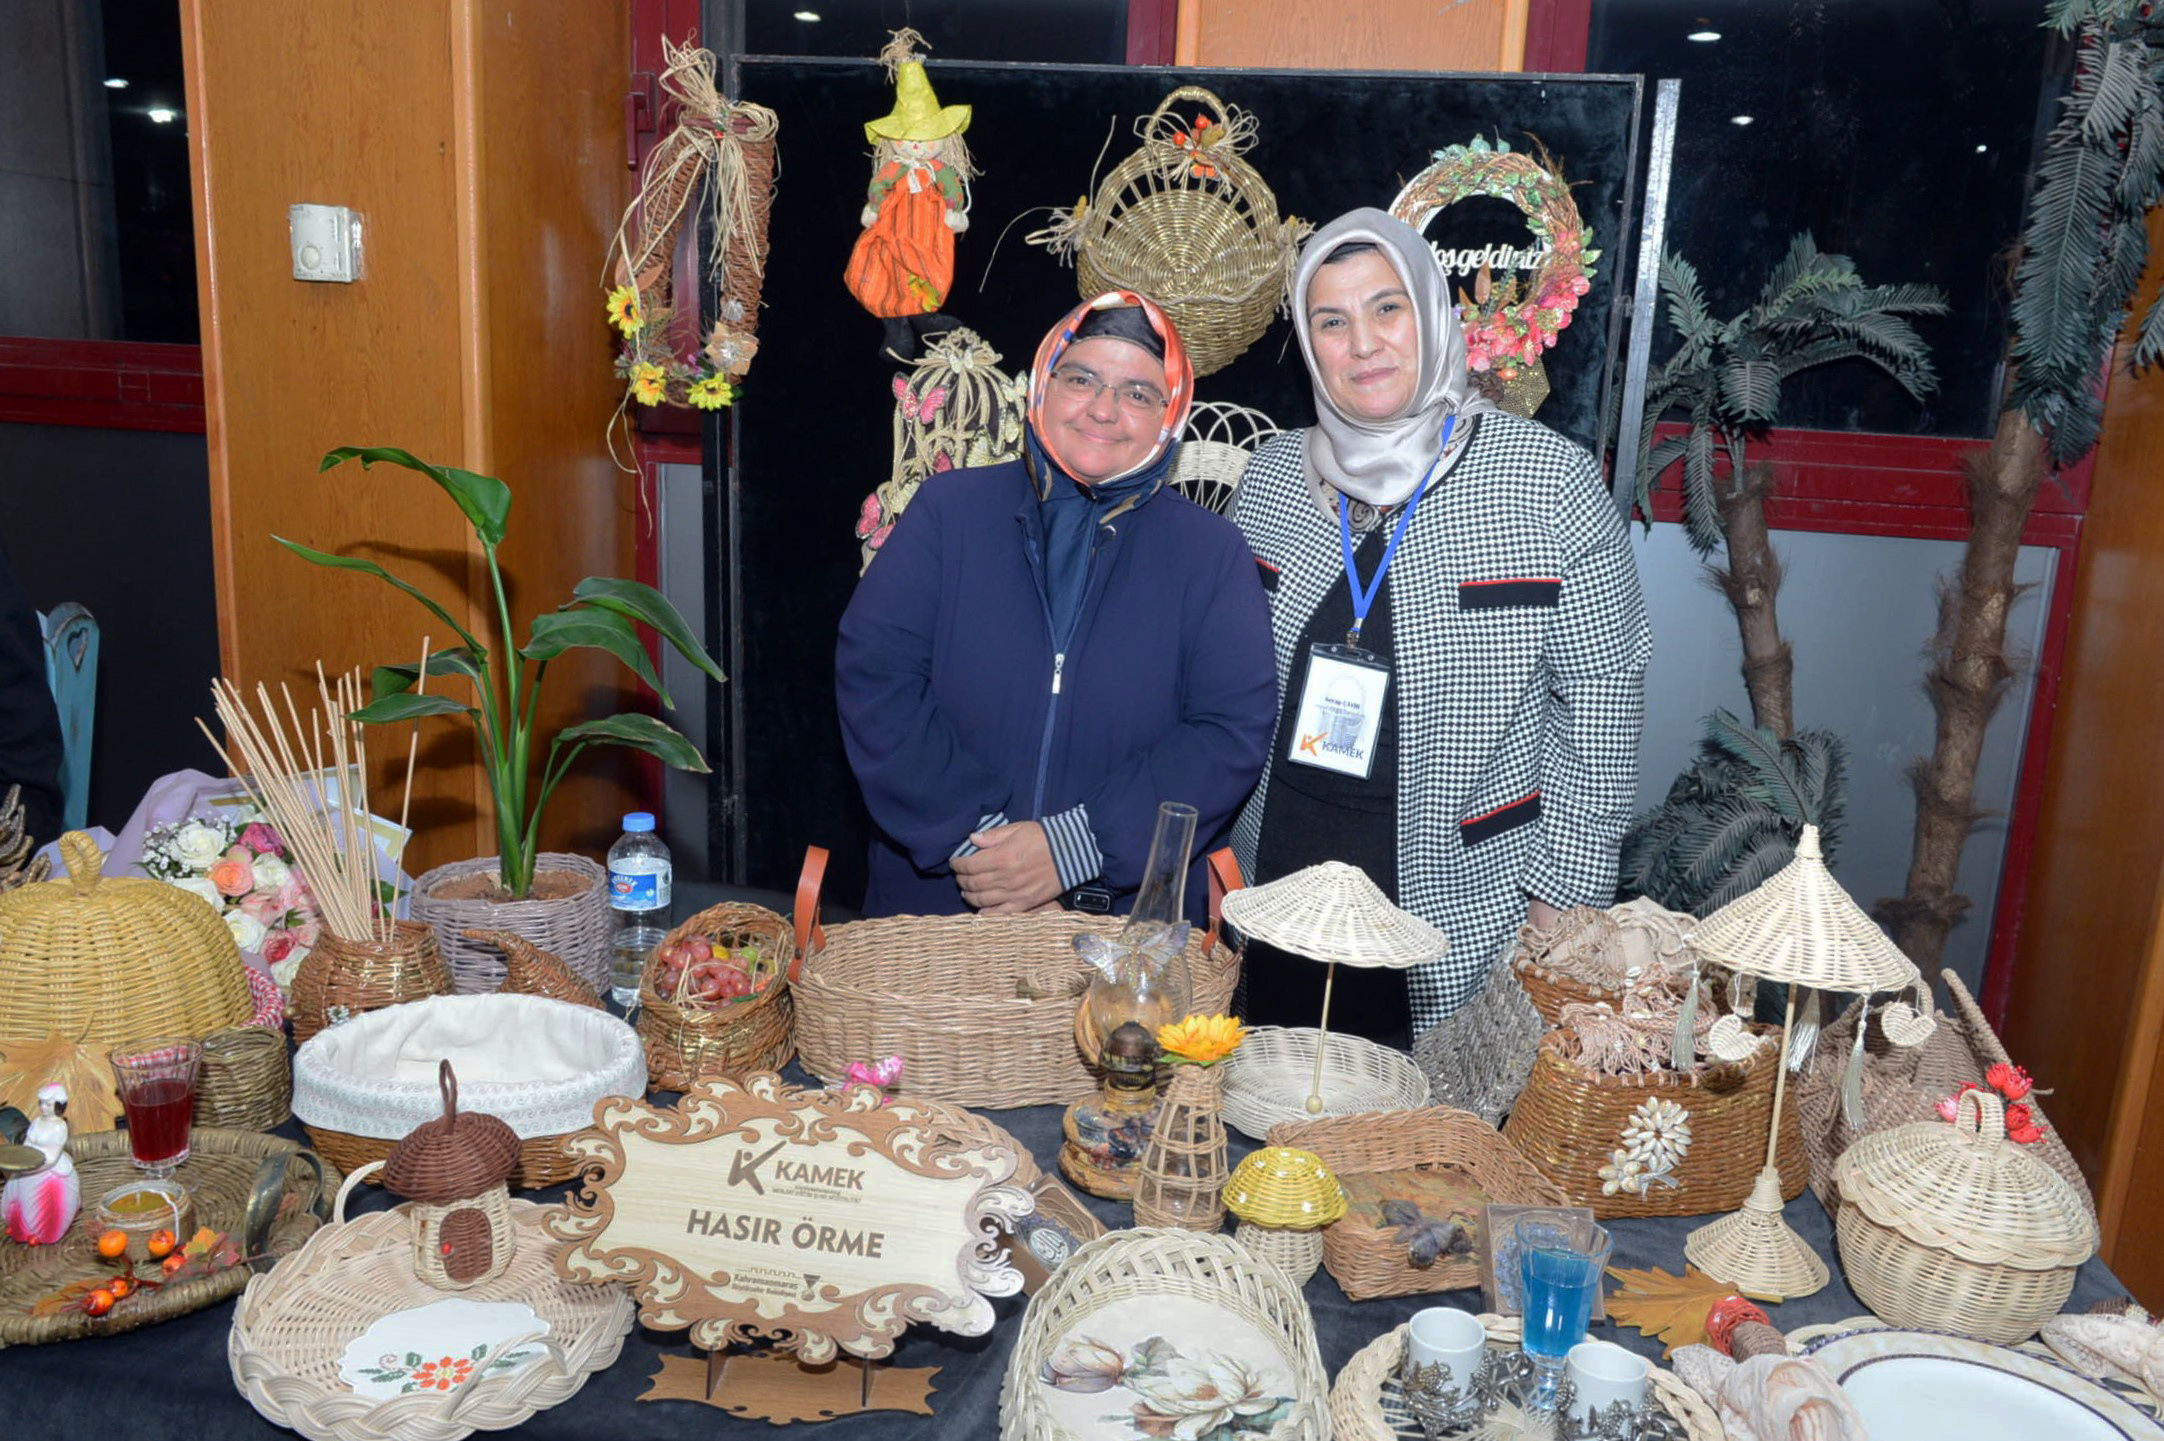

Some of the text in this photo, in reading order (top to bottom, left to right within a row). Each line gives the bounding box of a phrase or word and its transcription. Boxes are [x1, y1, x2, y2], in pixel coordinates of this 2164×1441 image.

[1321, 740, 1364, 760] KAMEK
[774, 1160, 866, 1191] KAMEK
[686, 1210, 885, 1259] HASIR ÖRME
